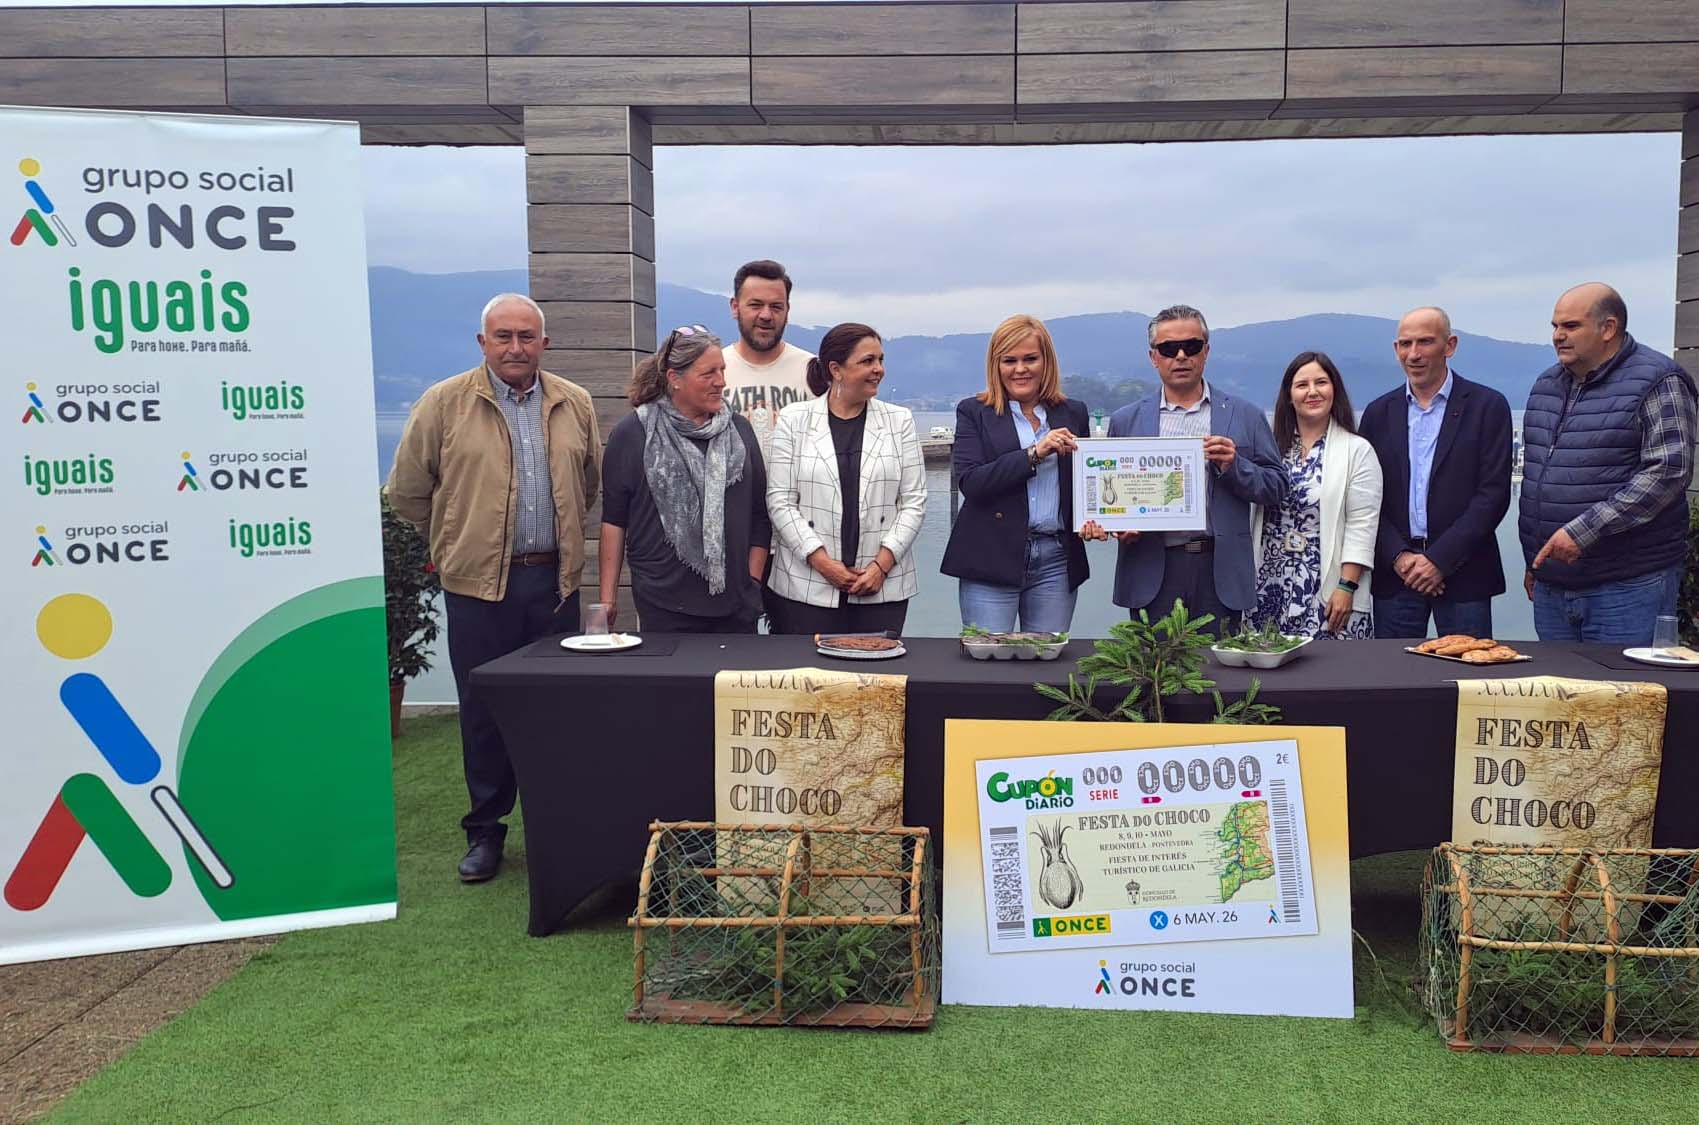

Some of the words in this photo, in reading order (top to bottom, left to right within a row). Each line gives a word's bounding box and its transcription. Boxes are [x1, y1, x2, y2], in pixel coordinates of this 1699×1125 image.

[82, 167, 189, 194] grupo
[199, 167, 294, 193] social
[85, 202, 296, 252] ONCE
[68, 266, 250, 354] iguais
[131, 340, 156, 352] Para
[191, 340, 216, 352] Para
[56, 384, 108, 398] grupo
[112, 380, 160, 395] social
[57, 399, 161, 423] ONCE
[221, 381, 304, 420] iguais
[209, 452, 258, 466] grupo
[262, 449, 307, 462] social
[1139, 456, 1182, 467] 00000
[24, 454, 114, 495] iguais
[210, 467, 308, 491] ONCE
[65, 525, 117, 540] grupo
[121, 520, 168, 535] social
[229, 517, 312, 557] iguais
[66, 539, 169, 565] ONCE
[731, 709, 836, 740] FESTA
[1475, 717, 1592, 750] FESTA
[731, 746, 777, 775] DO
[1276, 753, 1289, 764] 2€
[1082, 765, 1123, 786] 000
[1137, 755, 1262, 795] 00000
[1473, 756, 1526, 787] DO
[729, 784, 842, 816] CHOCO
[1089, 789, 1119, 801] SERIE
[1078, 814, 1130, 831] FESTA
[1133, 815, 1152, 827] DO
[1154, 809, 1211, 826] CHOCO
[1471, 796, 1596, 830] CHOCO
[1150, 830, 1173, 838] MAYO
[1100, 842, 1147, 850] REDONDELA
[1108, 855, 1138, 864] FIESTA
[1149, 865, 1160, 873] DE
[1162, 863, 1196, 872] GALICIA
[1055, 917, 1107, 933] ONCE
[1173, 915, 1181, 925] 6
[1185, 911, 1219, 924] MAY.
[1223, 911, 1238, 922] 26
[1120, 962, 1157, 974] grupo
[1160, 961, 1196, 973] social
[1120, 976, 1196, 998] ONCE
